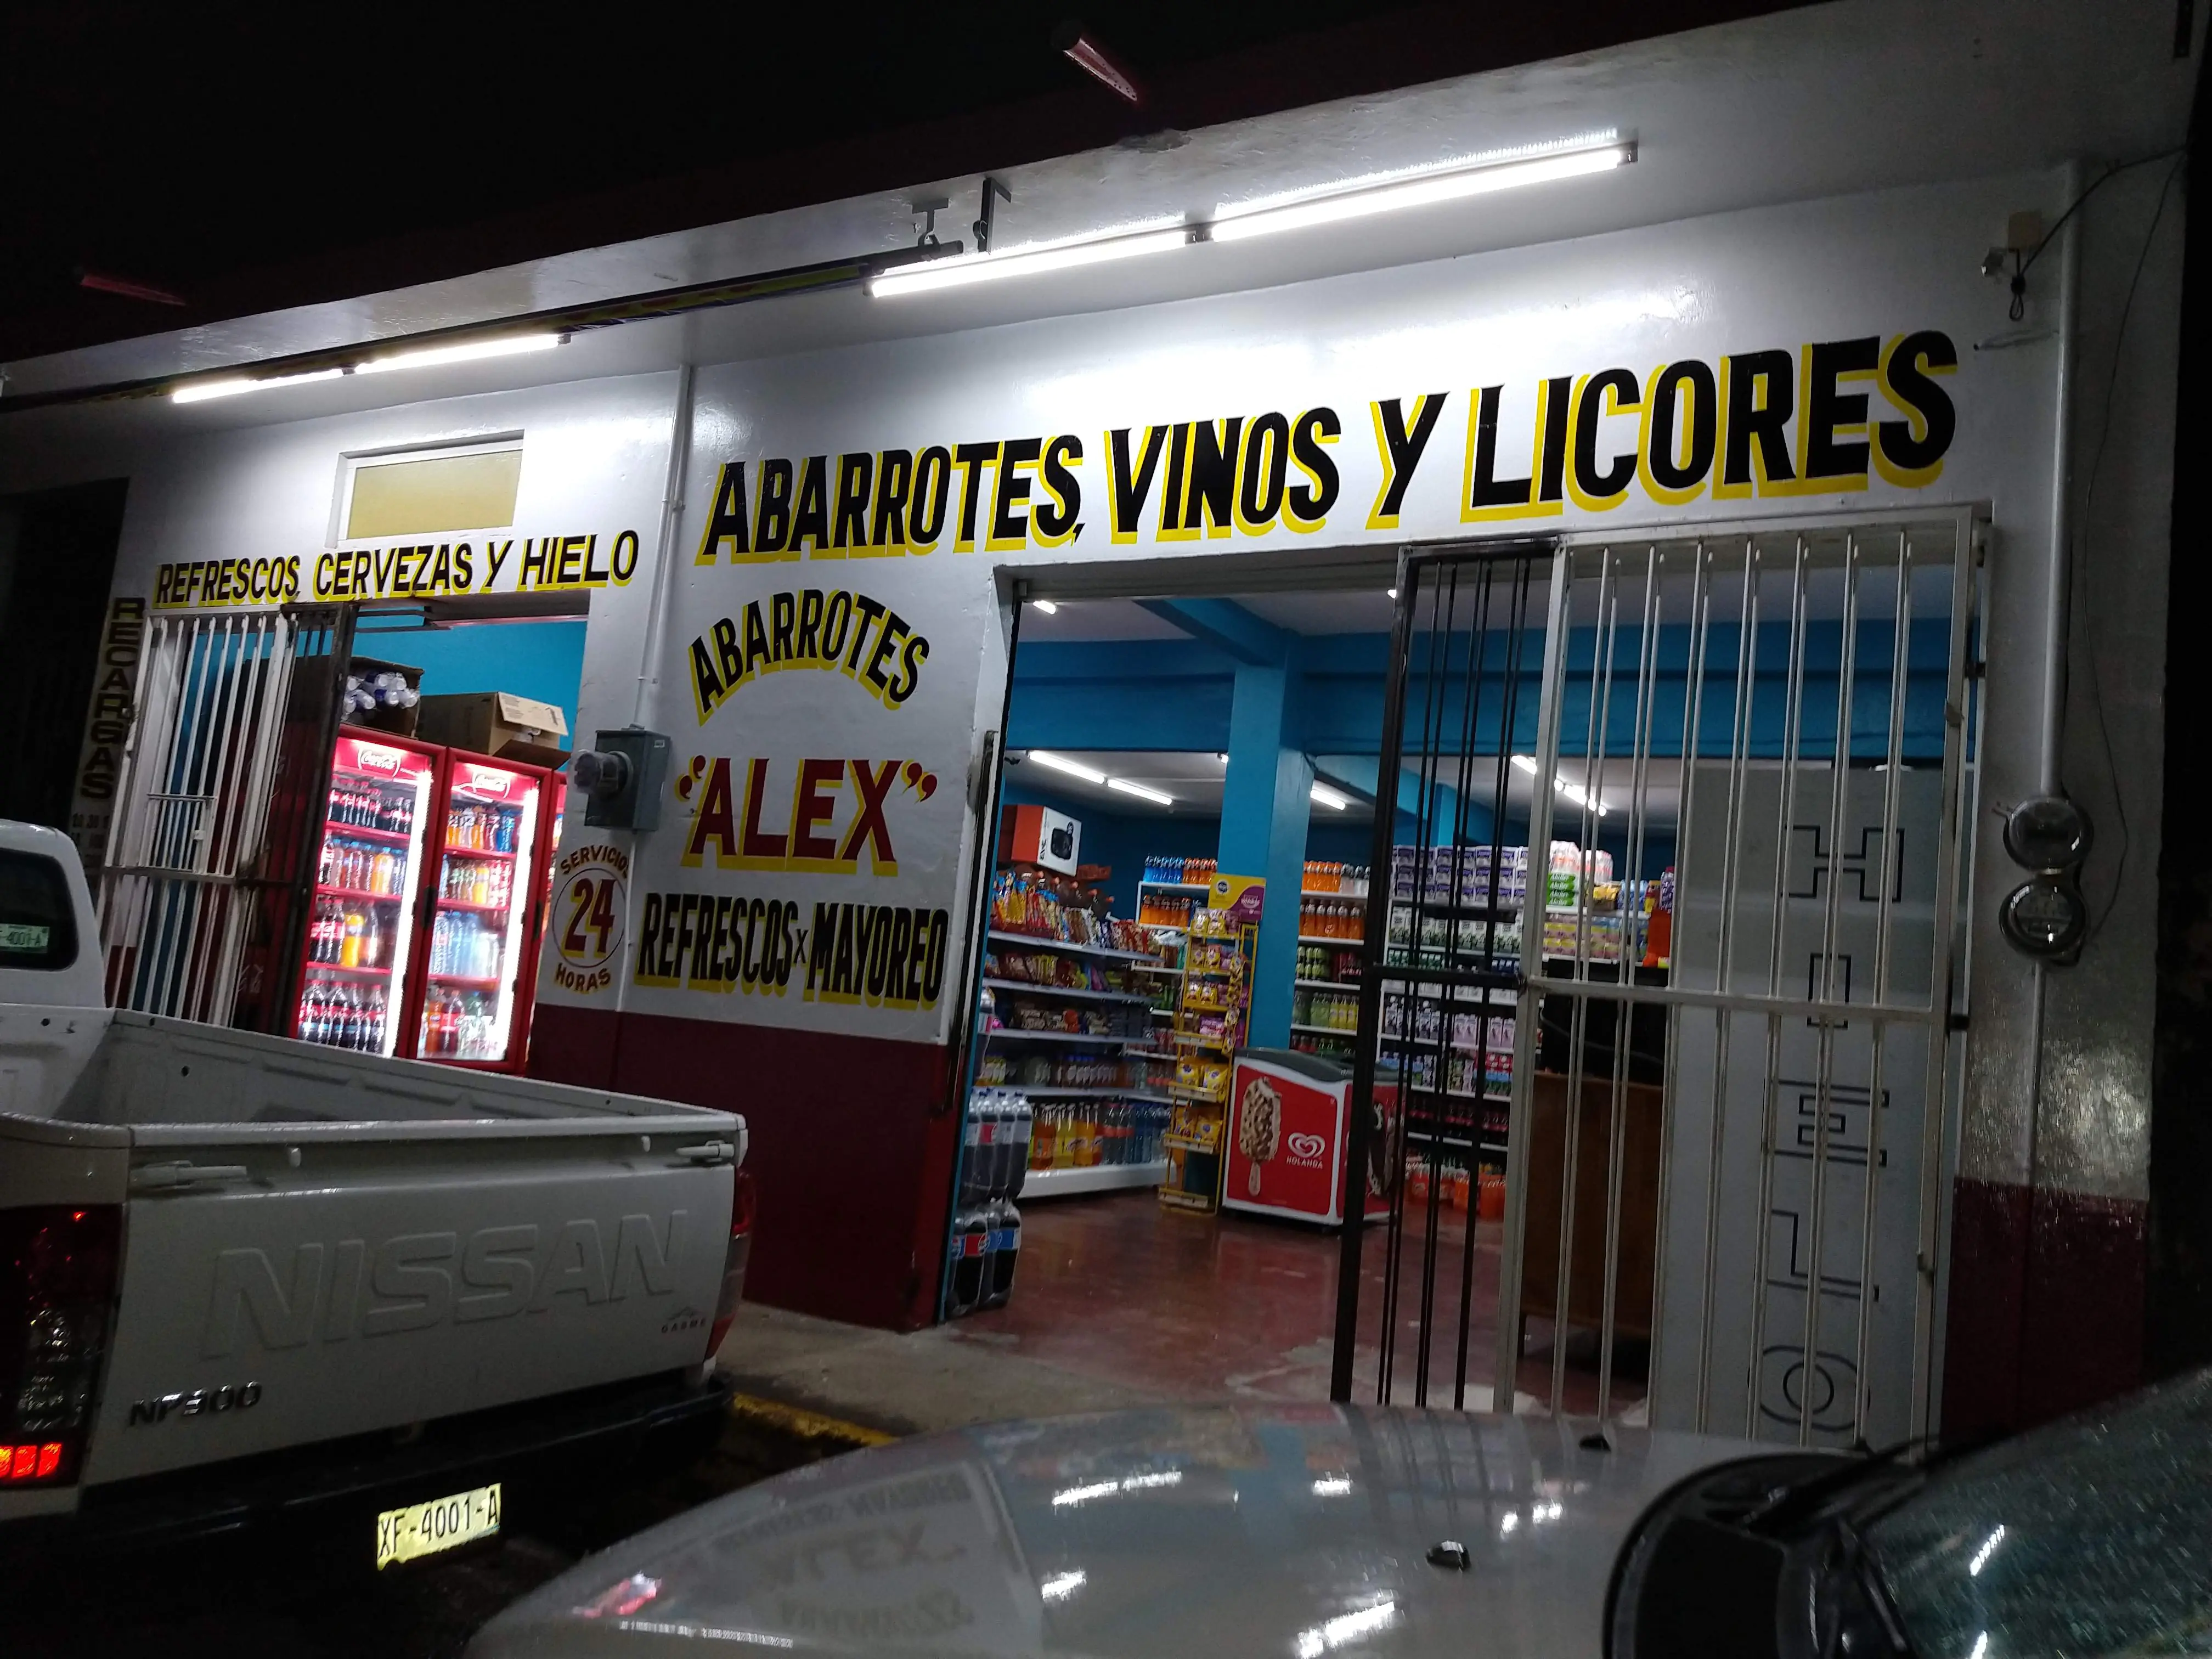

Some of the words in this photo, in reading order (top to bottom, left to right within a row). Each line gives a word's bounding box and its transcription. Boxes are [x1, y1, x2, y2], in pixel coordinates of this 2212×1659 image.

[694, 435, 1086, 566] ABARROTES,
[1104, 407, 1341, 544] VINOS
[1365, 391, 1451, 531] Y
[1460, 330, 1958, 523] LICORES
[153, 554, 302, 609] REFRESCOS
[313, 541, 473, 602] CERVEZAS
[481, 539, 515, 594] Y
[518, 529, 640, 592] HIELO
[688, 589, 930, 727] ABARROTES
[561, 877, 617, 959] 24
[633, 892, 799, 998] REFRESCOS
[803, 901, 949, 1011] MAYOREO
[555, 962, 612, 995] HORAS
[1286, 1155, 1324, 1170] HOLANDA
[201, 1210, 688, 1362] NISSAN
[380, 1488, 499, 1559] XF-4001-A
